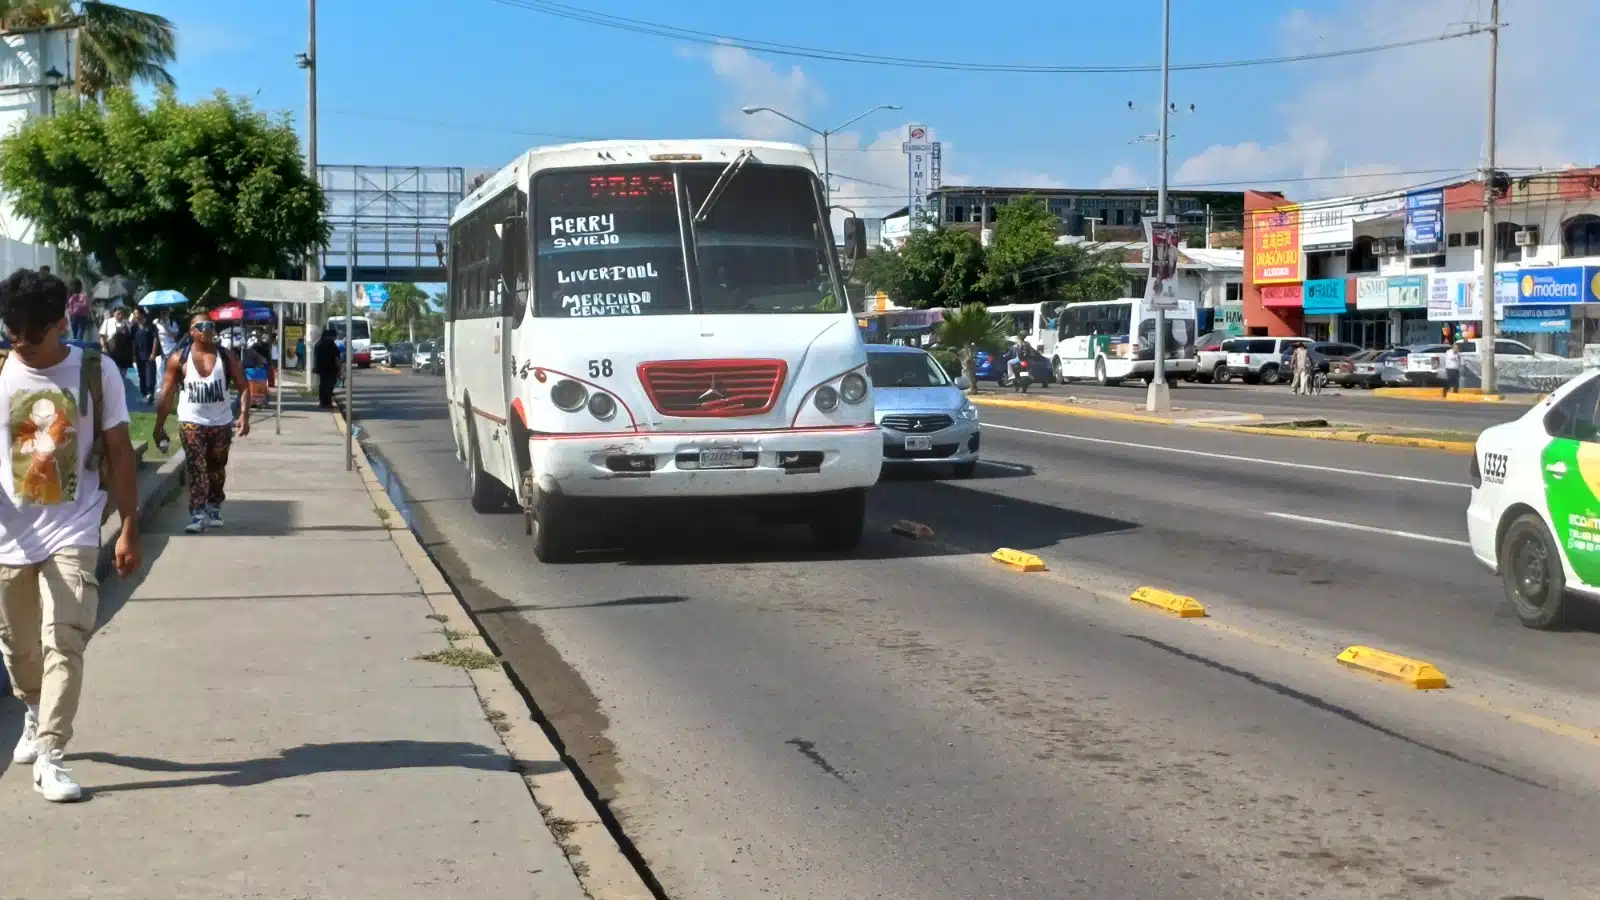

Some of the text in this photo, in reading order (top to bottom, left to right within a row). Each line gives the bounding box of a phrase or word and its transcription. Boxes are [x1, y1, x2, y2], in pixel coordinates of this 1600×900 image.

[550, 213, 614, 236] FERRY
[553, 234, 620, 248] S.VIEJO
[557, 262, 658, 284] LIVERPOOL
[1533, 281, 1577, 297] moderna
[562, 291, 651, 308] MERCADO
[570, 304, 641, 317] CENTRO
[588, 358, 613, 378] 58
[1484, 452, 1508, 478] 13323
